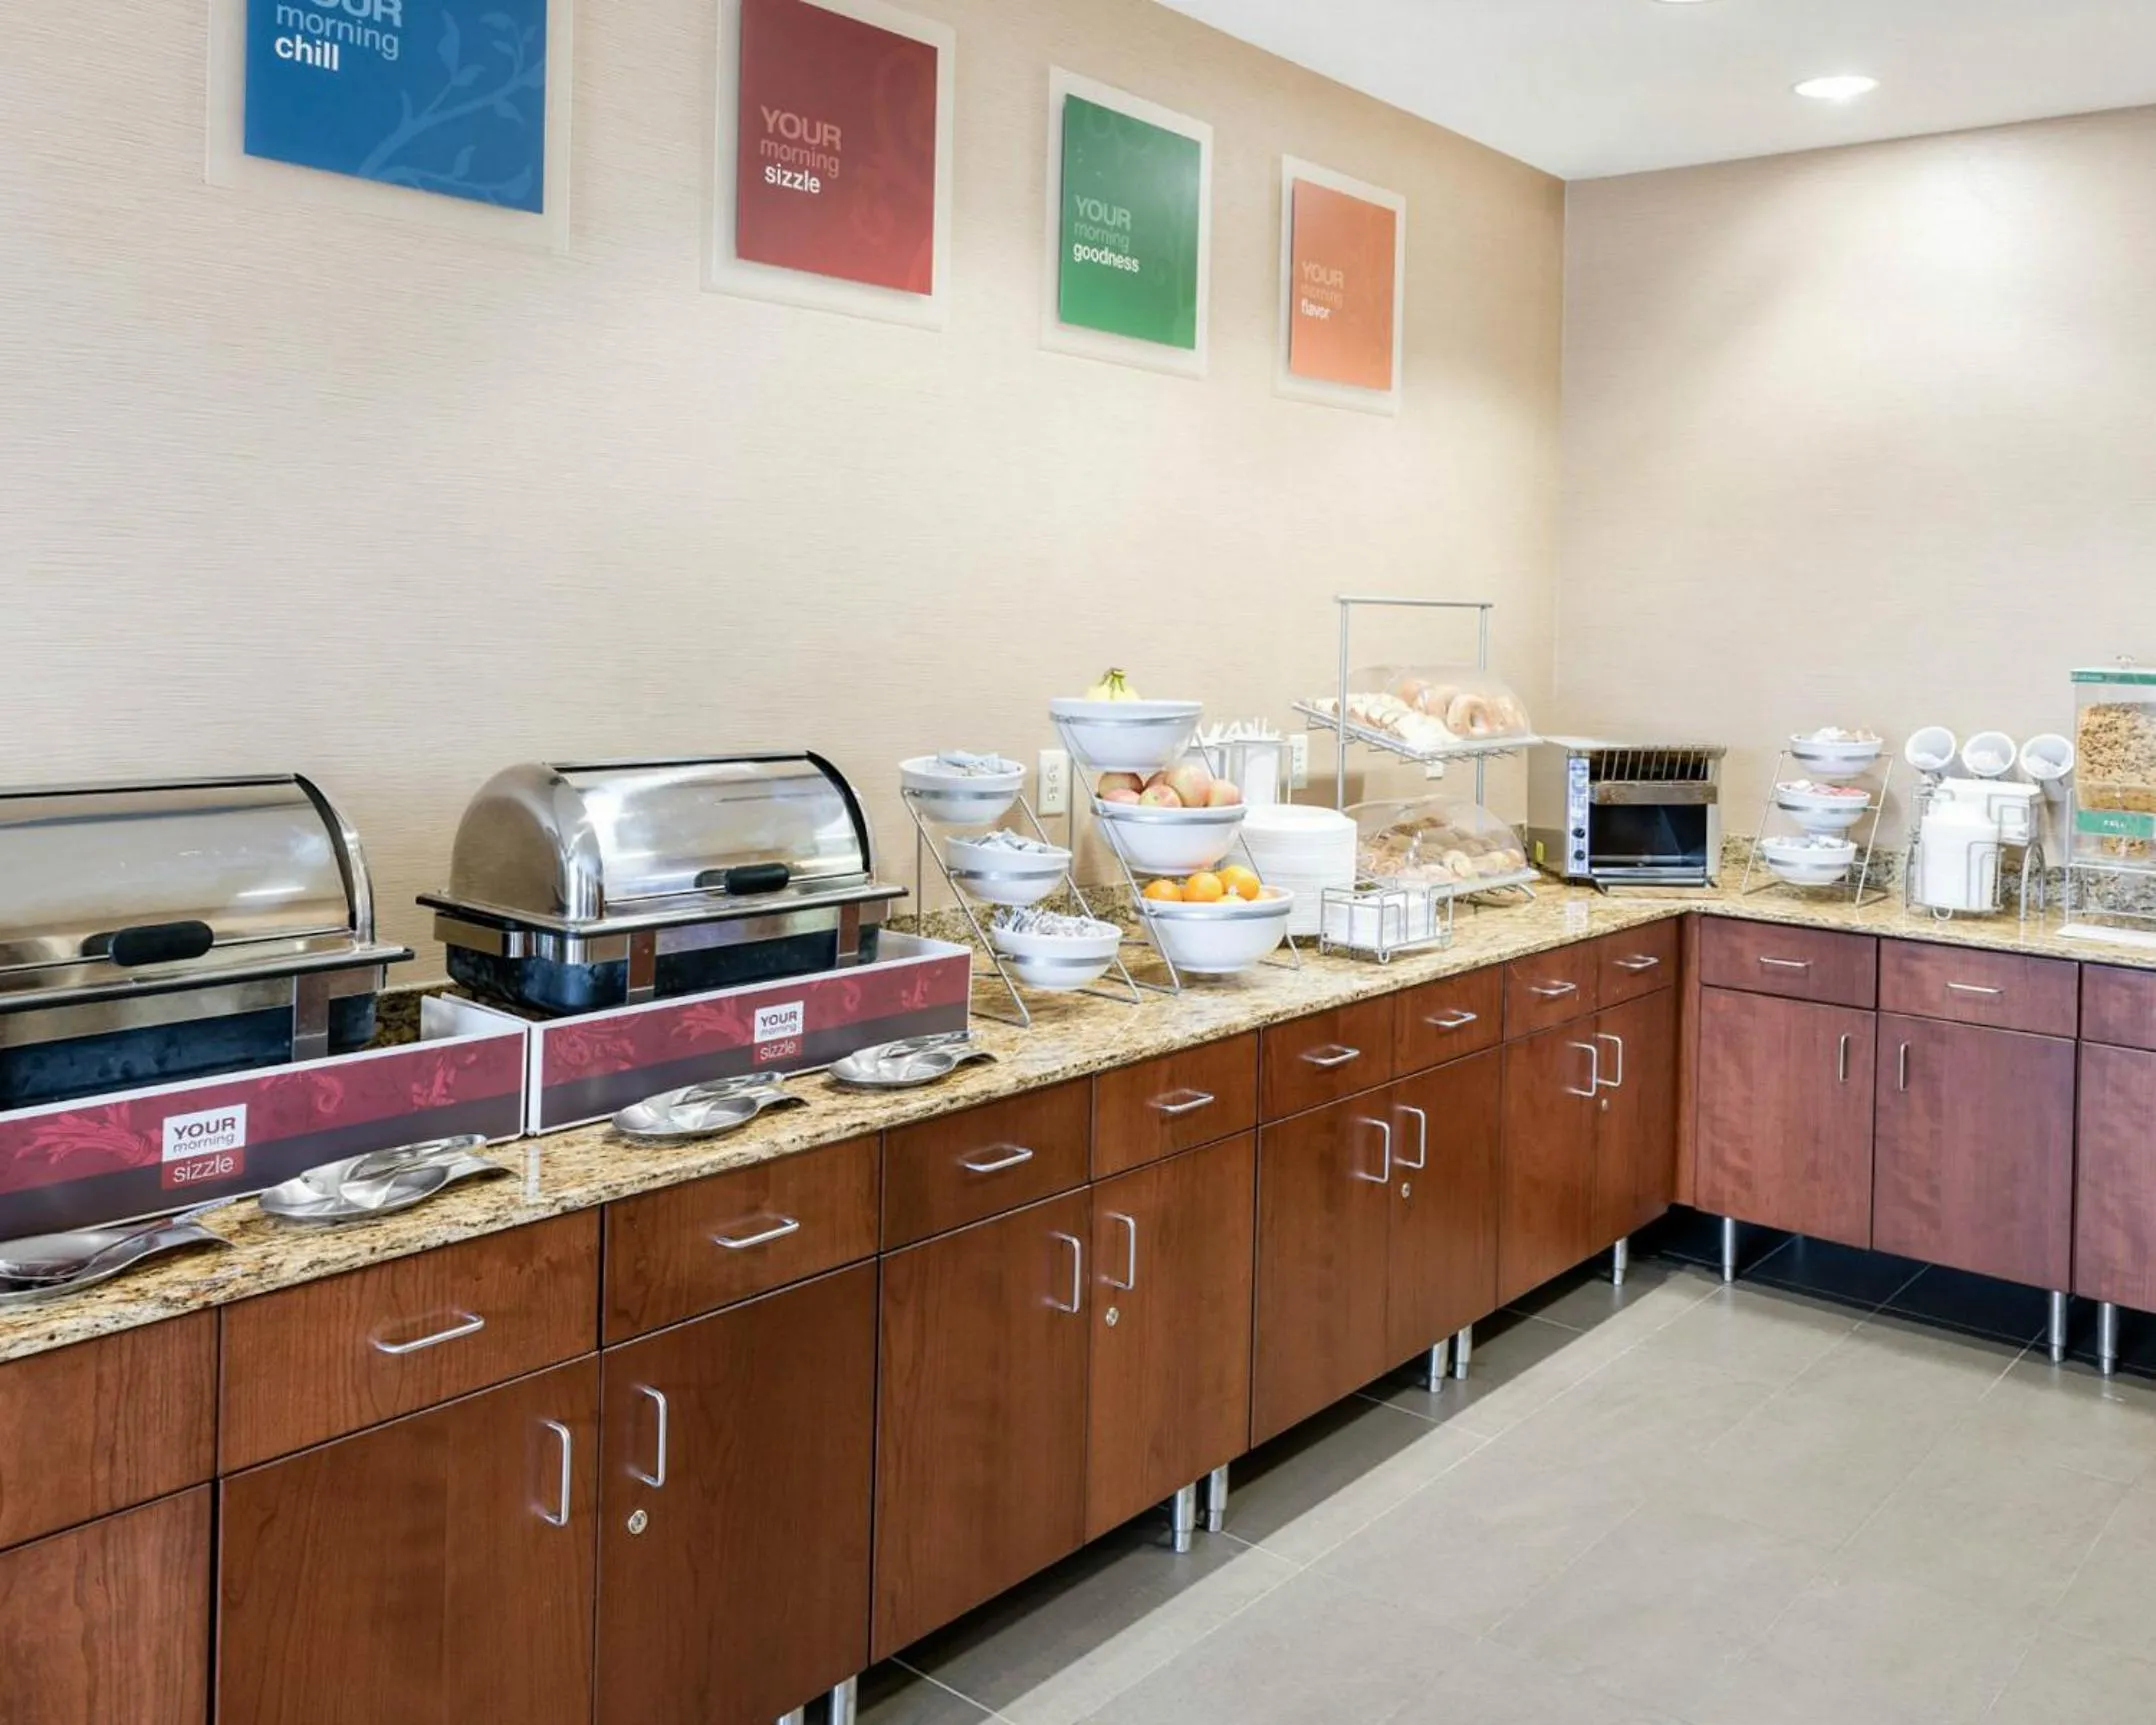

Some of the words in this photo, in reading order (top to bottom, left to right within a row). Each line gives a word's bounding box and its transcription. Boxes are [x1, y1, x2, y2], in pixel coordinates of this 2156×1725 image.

[276, 3, 399, 61] morning
[274, 33, 340, 72] chill
[760, 103, 842, 152] YOUR
[760, 138, 840, 179] morning
[764, 162, 821, 194] sizzle
[1075, 194, 1132, 232] YOUR
[1073, 221, 1130, 255] morning
[1073, 243, 1140, 273] goodness
[1301, 260, 1344, 290] YOUR
[1301, 298, 1331, 320] flavor
[759, 1011, 798, 1027] YOUR
[760, 1023, 797, 1036] morning
[759, 1039, 797, 1061] sizzle
[173, 1117, 236, 1140] YOUR
[173, 1133, 235, 1153] morning
[173, 1154, 234, 1183] sizzle
